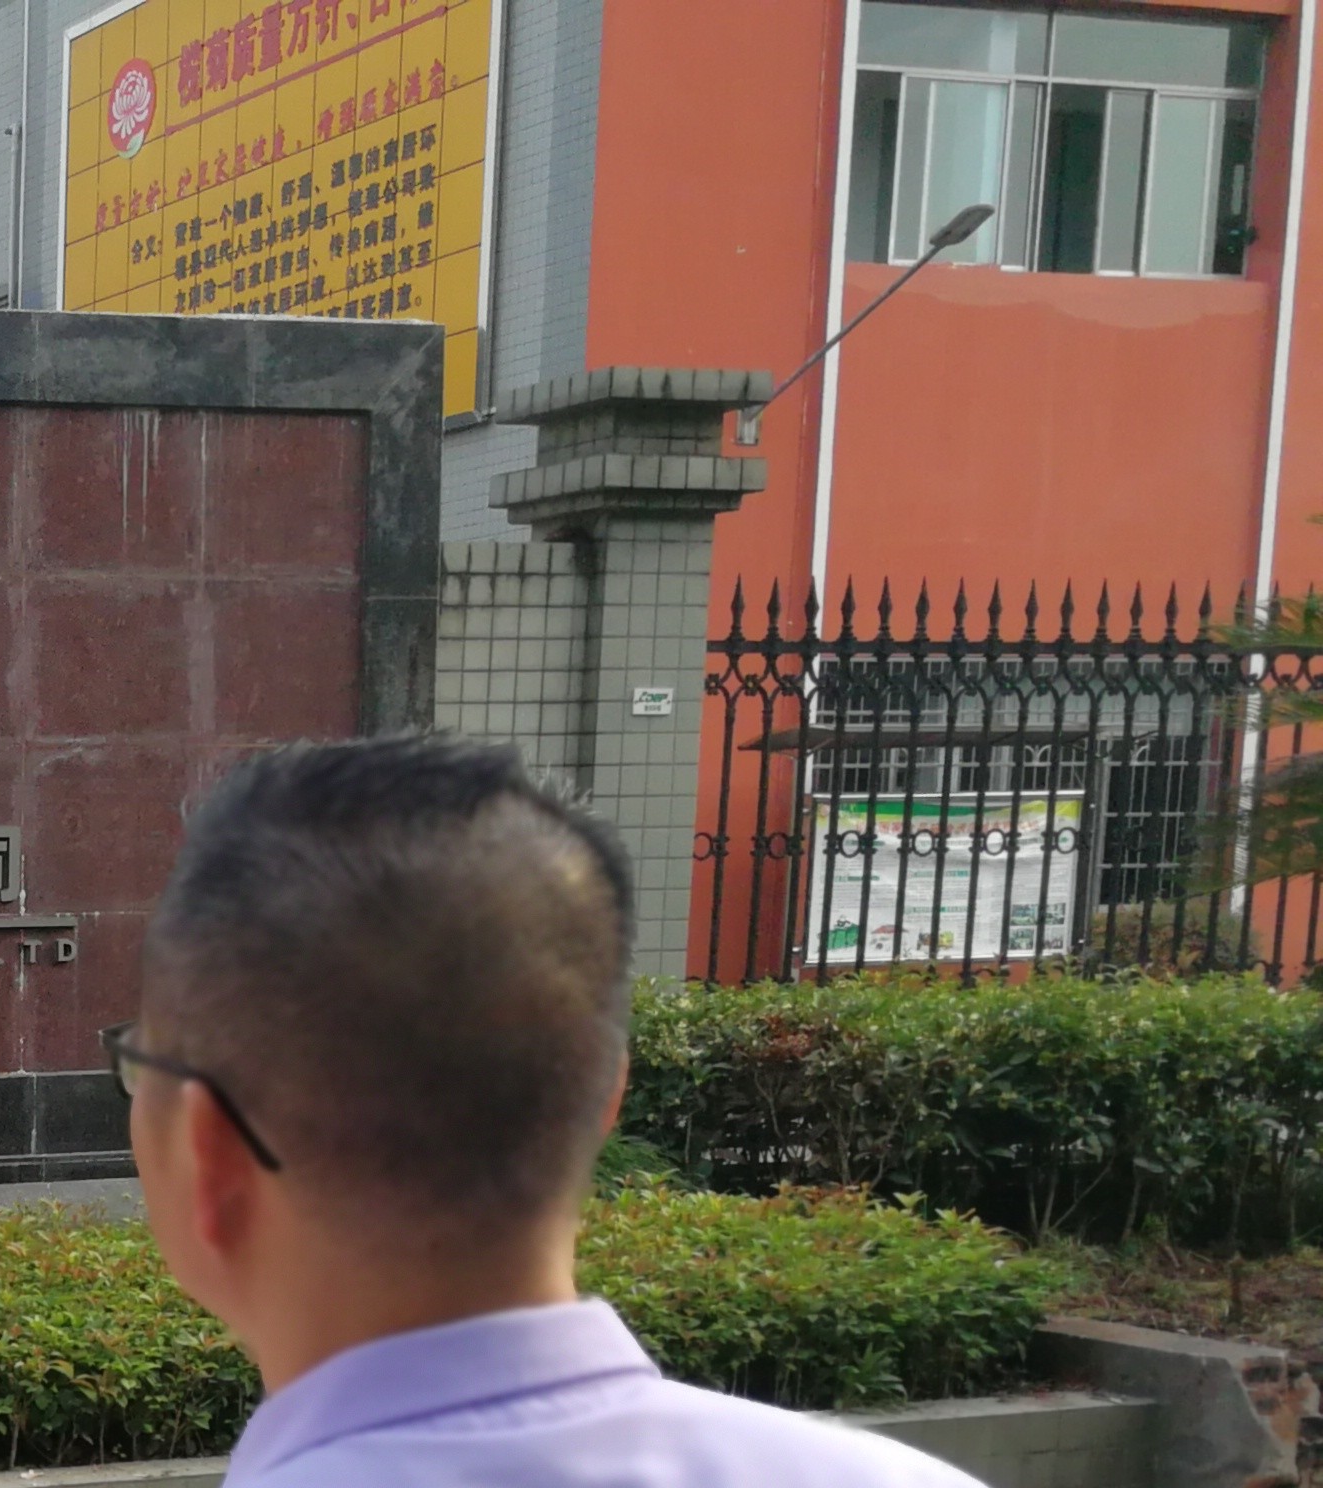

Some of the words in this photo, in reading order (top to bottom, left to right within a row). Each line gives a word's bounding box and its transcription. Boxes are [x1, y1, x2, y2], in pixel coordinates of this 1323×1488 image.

[177, 0, 417, 108] 榄菊质量方针、
